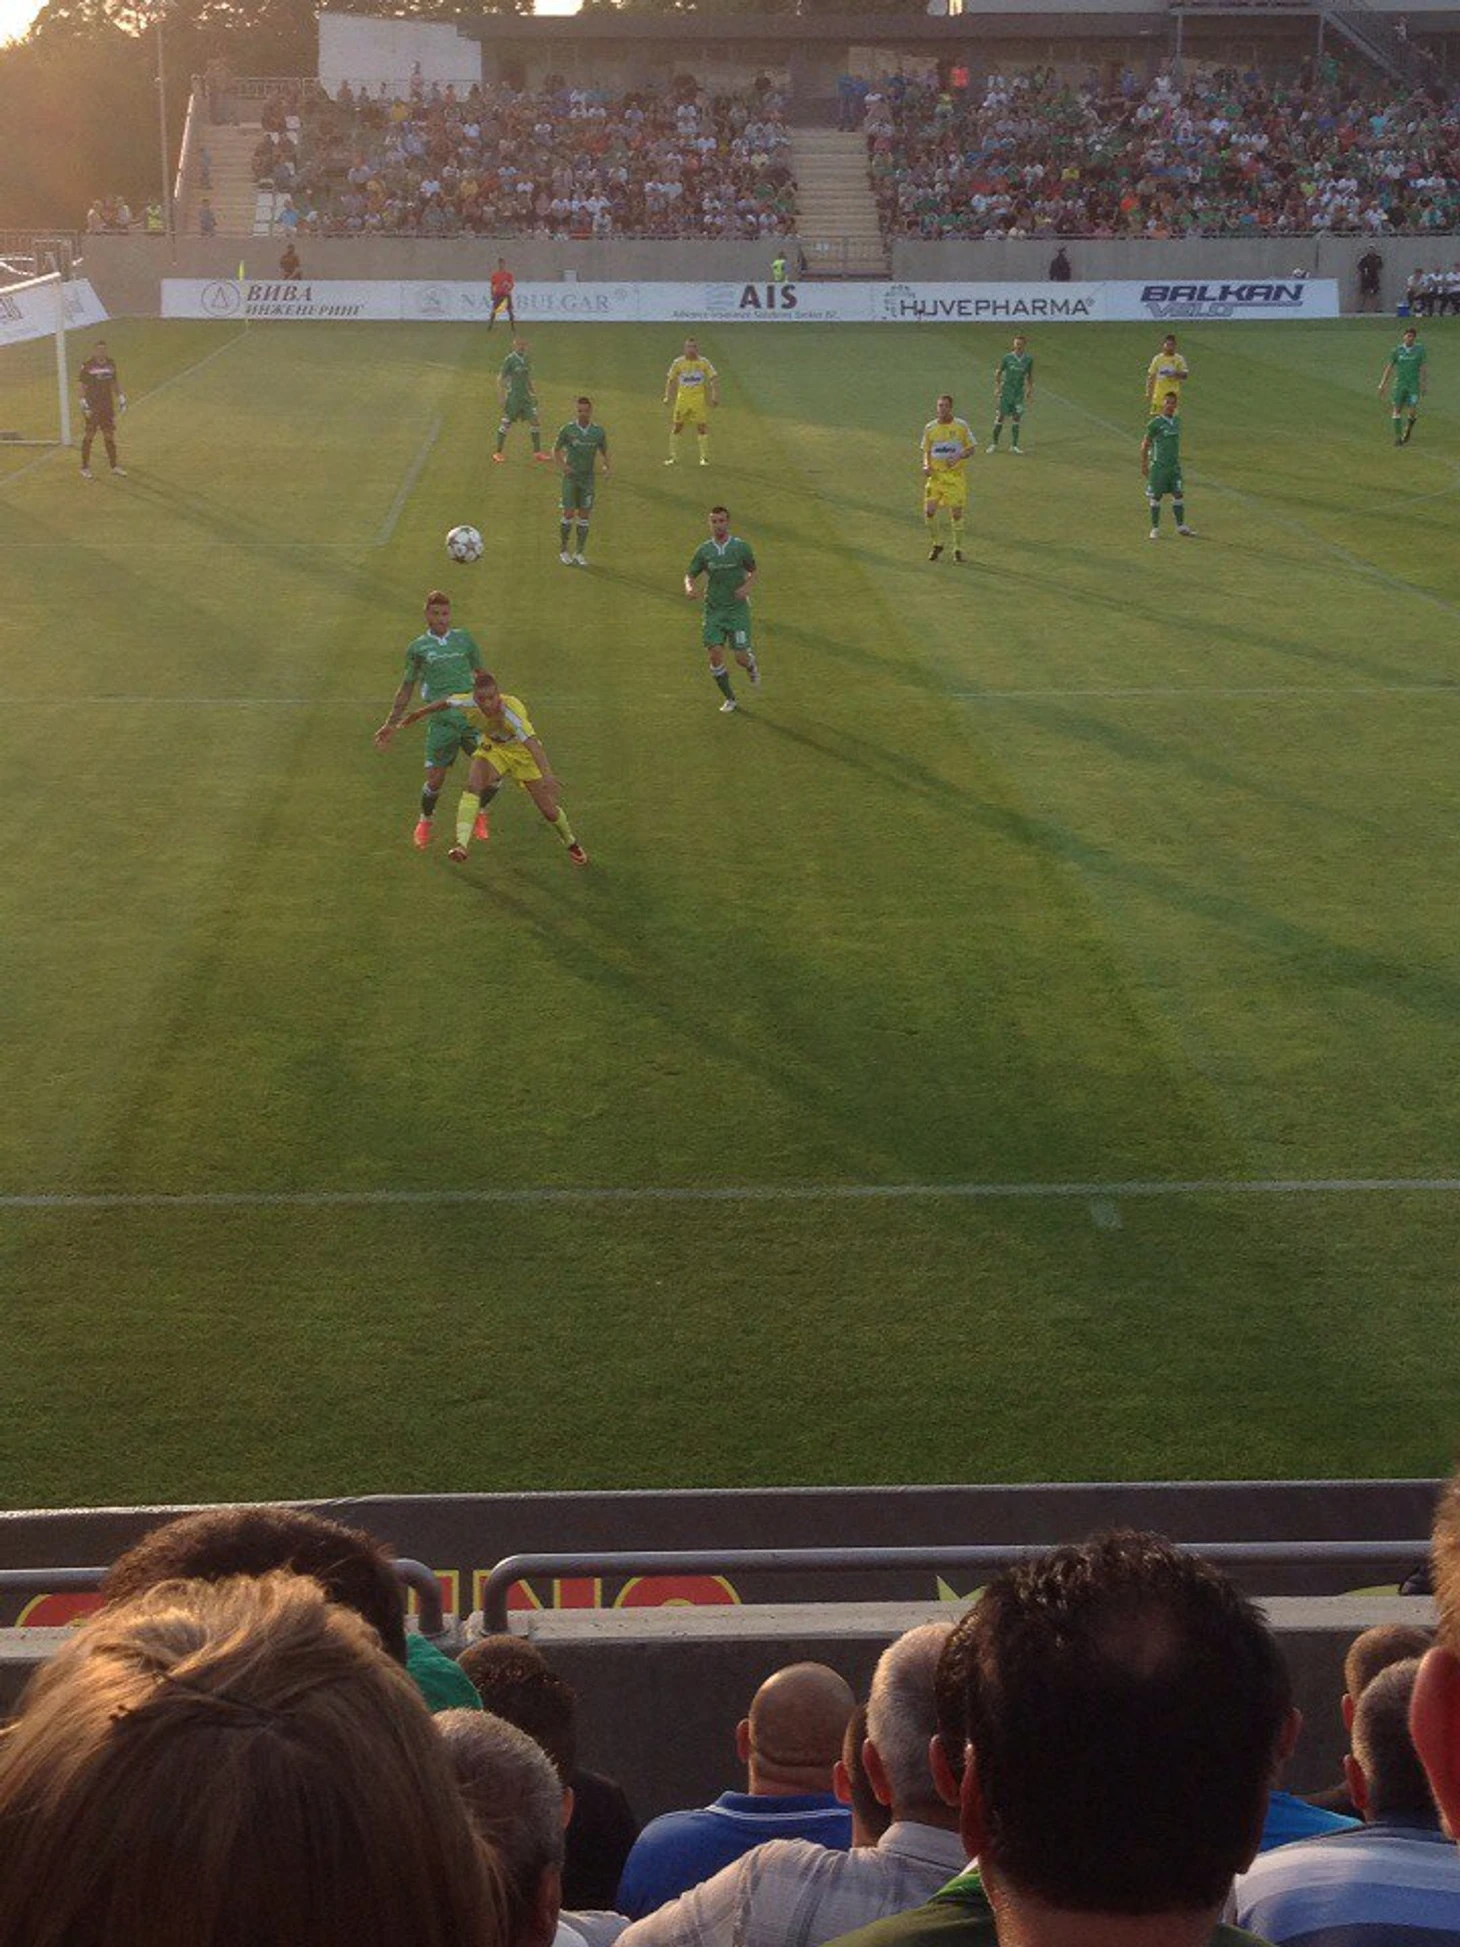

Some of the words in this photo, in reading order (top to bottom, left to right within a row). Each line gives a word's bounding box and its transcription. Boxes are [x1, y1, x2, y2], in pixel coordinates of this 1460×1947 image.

[247, 284, 312, 301] ВИВА
[740, 284, 798, 309] AIS
[1141, 284, 1303, 301] BALKAN
[900, 299, 1090, 316] HUVEPHARMA
